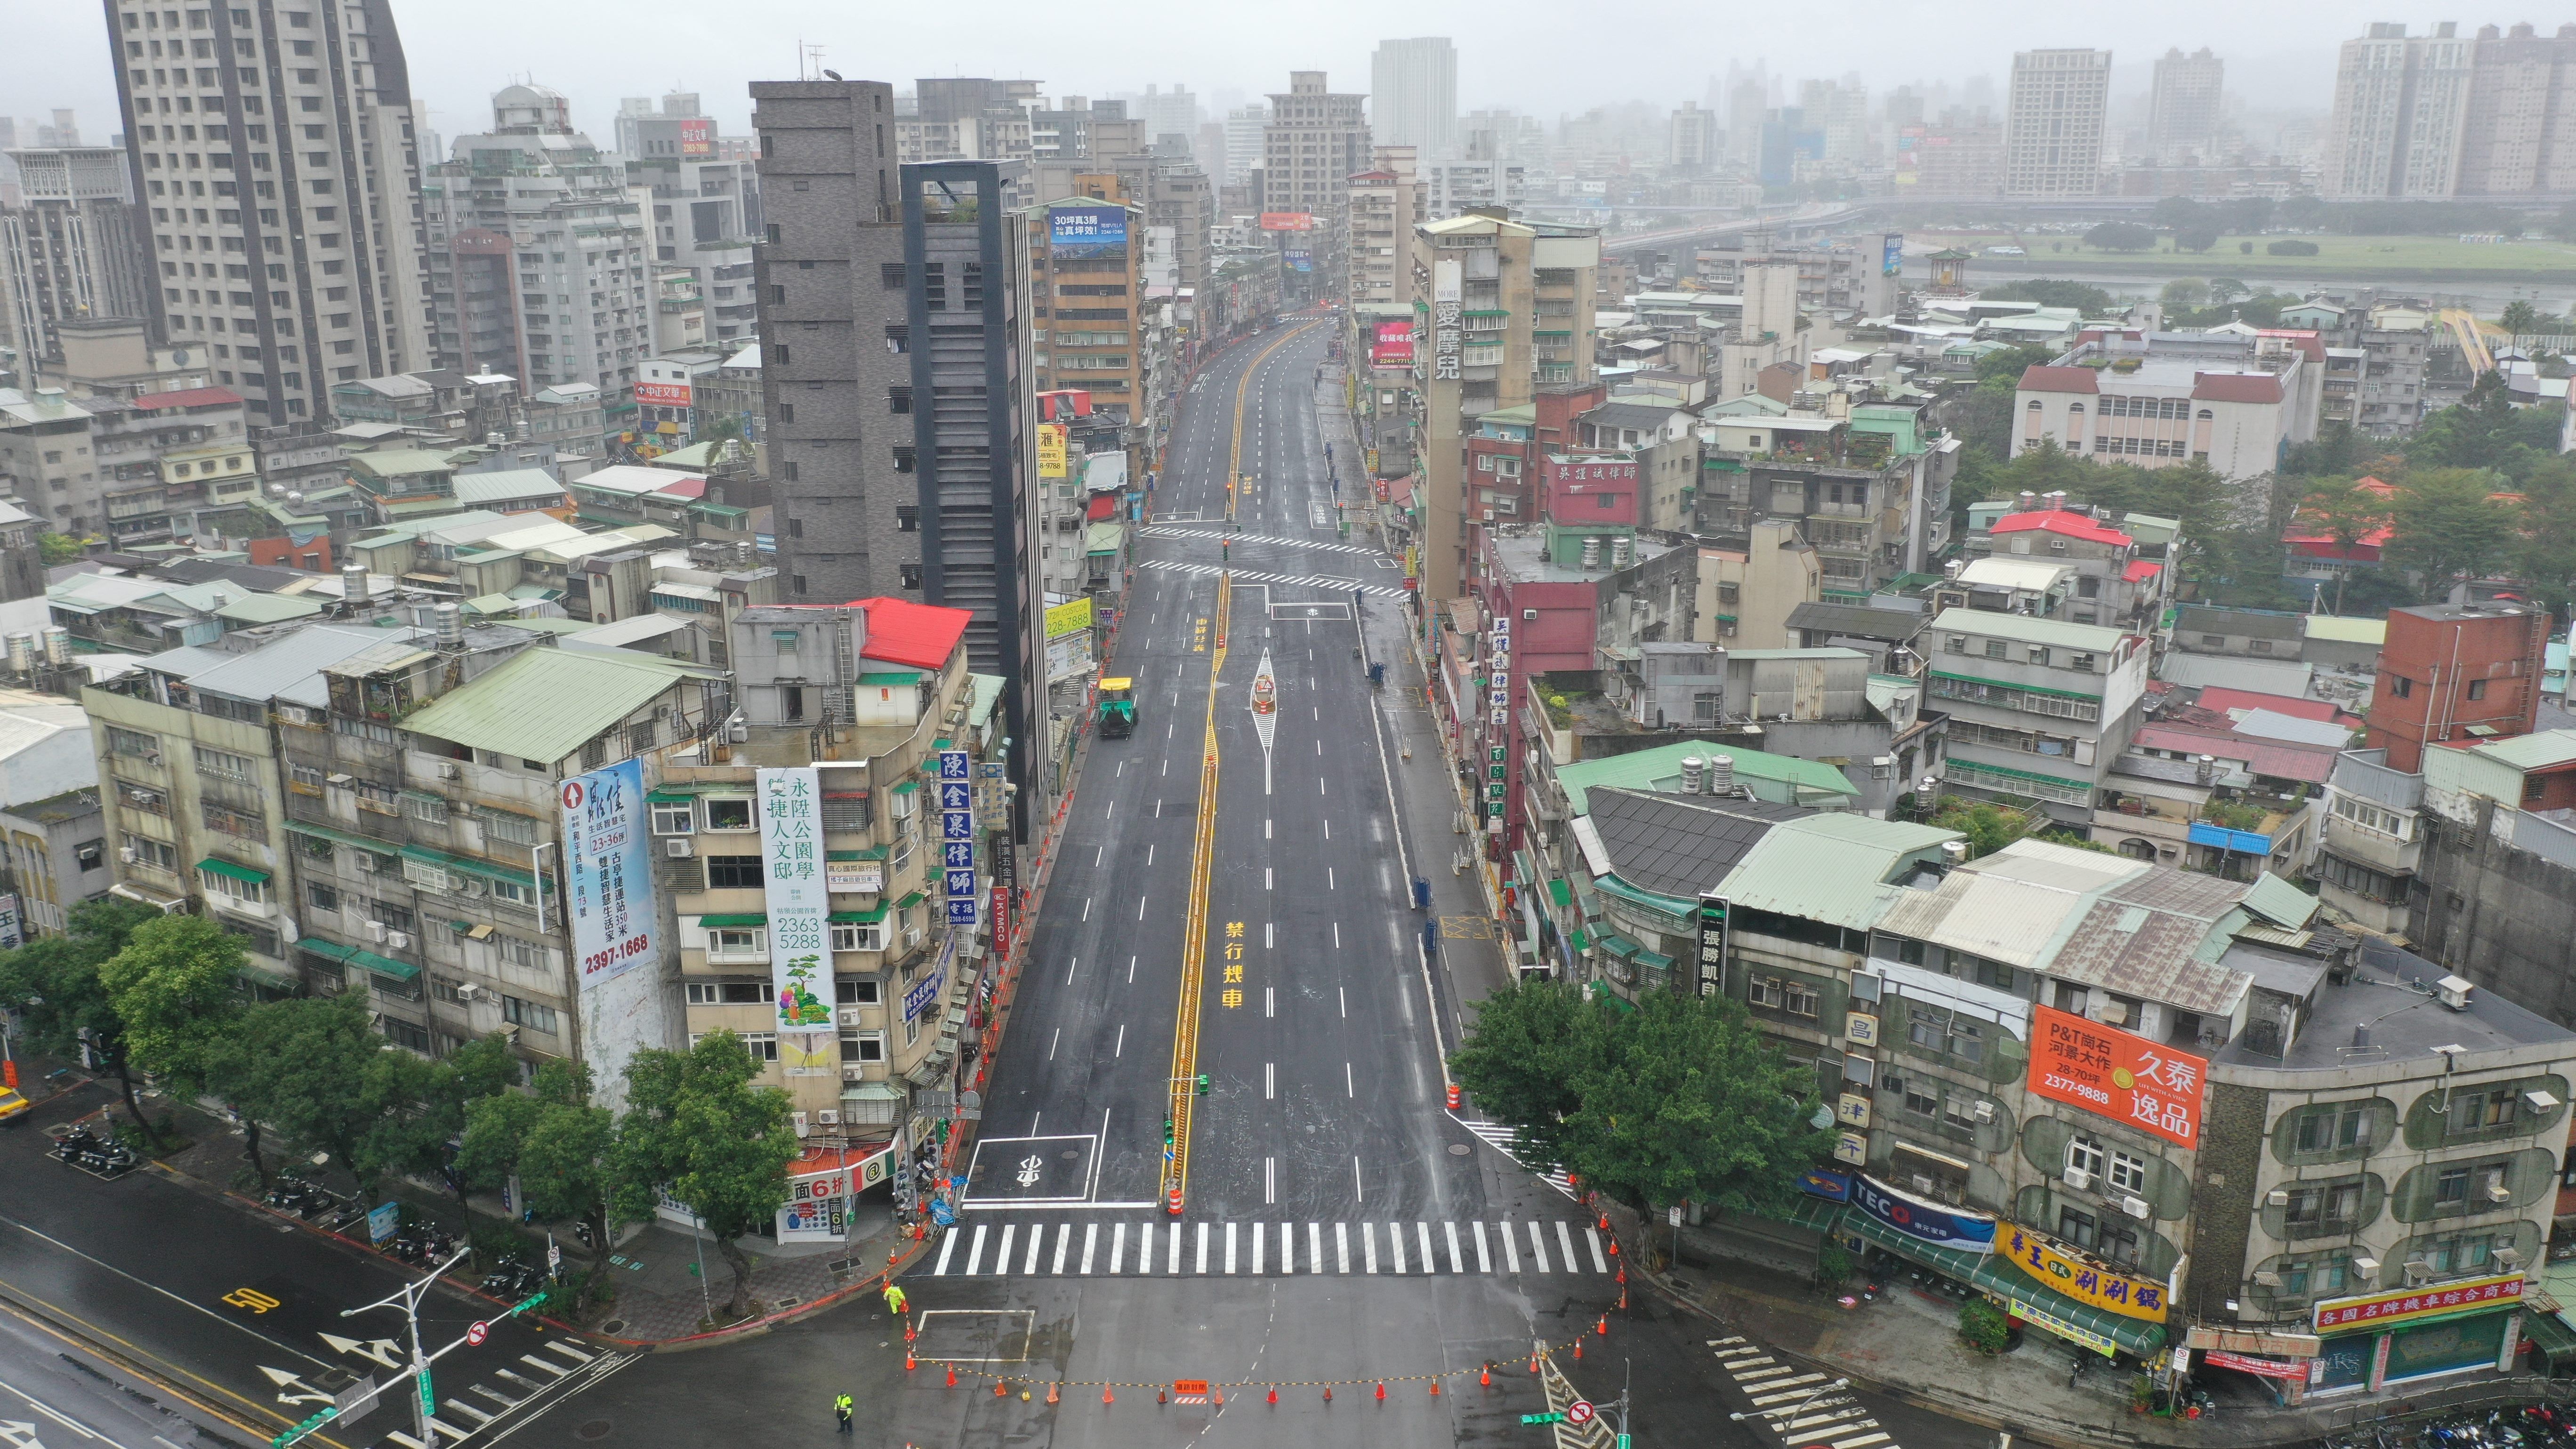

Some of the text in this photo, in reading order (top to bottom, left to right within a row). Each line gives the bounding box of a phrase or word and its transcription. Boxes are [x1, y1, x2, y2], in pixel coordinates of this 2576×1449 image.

[683, 129, 707, 141] 中正文華
[1055, 216, 1097, 225] 30坪真3房
[1065, 226, 1097, 235] 真坪效!
[1436, 301, 1460, 379] 愛摩兒
[646, 386, 680, 398] 中正文華
[1559, 466, 1635, 481] 吳謹斌律師
[1493, 619, 1507, 705] 吳謹斌律師
[588, 814, 626, 834] 生活智慧宅
[767, 778, 793, 880] 雙捷人文邸
[790, 778, 815, 880] 永陞公園學
[943, 754, 970, 894] 陳金泉律師
[592, 831, 626, 853] 23-36坪
[572, 831, 587, 918] 和平西路一段73號
[598, 856, 615, 943] 雙捷智慧生活家
[612, 852, 628, 937] 古亭捷運站350米
[950, 903, 973, 914] 電話
[778, 918, 819, 933] 2363
[997, 902, 1005, 942] KYMCO
[585, 934, 648, 975] 2397-1668
[780, 934, 821, 949] 5288
[1222, 921, 1244, 1008] 禁行機車
[906, 976, 935, 1012] 陳金泉律師
[1851, 1020, 1871, 1039] 昌
[2051, 1023, 2112, 1055] P&T崗石
[2048, 1039, 2111, 1071] 河景大作
[2045, 1073, 2109, 1104] 2377-9888
[2056, 1062, 2101, 1084] 28-70坪
[2134, 1051, 2197, 1095] 久泰
[2139, 1083, 2149, 1091] LIFE
[2151, 1086, 2166, 1096] WITH
[2172, 1093, 2187, 1103] VIEW
[2130, 1090, 2190, 1138] 逸品
[1856, 1181, 1910, 1223] TECO
[1915, 1222, 1947, 1237] 東元家電
[2010, 1231, 2045, 1271] 華王
[2050, 1262, 2068, 1278] 日式
[222, 1288, 280, 1314] 50
[2075, 1269, 2162, 1311] 涮涮鍋
[2320, 1281, 2522, 1325] 各國名牌機車綜合商場
[2194, 1333, 2315, 1353] 高價收購中古機車
